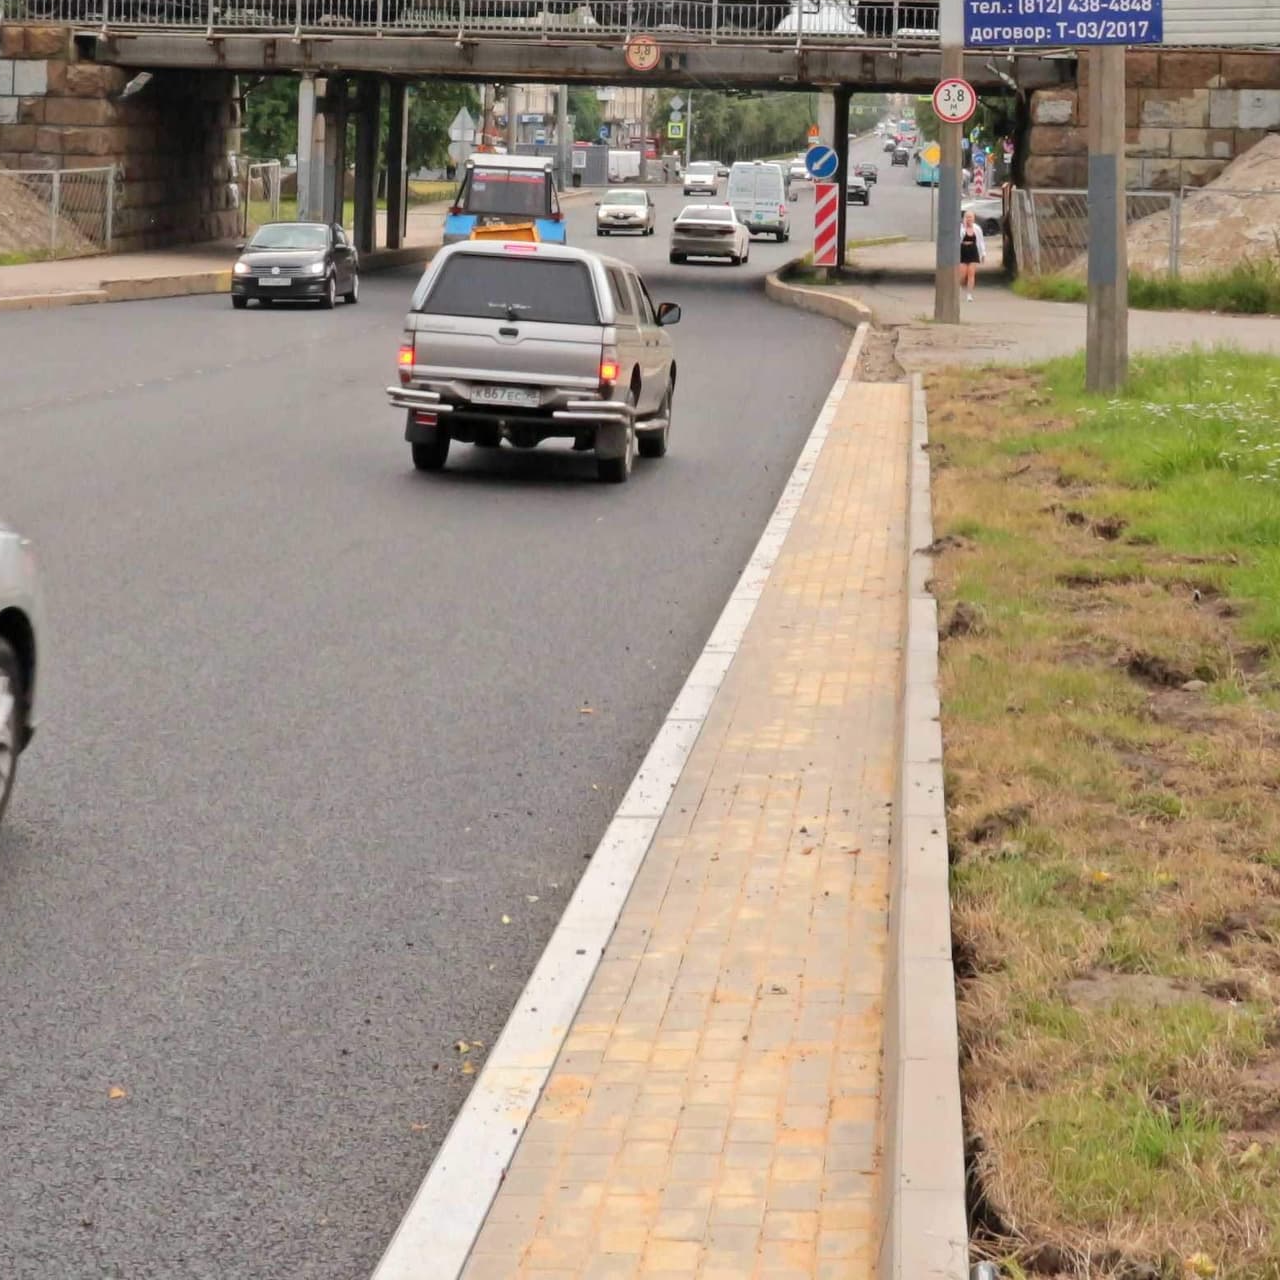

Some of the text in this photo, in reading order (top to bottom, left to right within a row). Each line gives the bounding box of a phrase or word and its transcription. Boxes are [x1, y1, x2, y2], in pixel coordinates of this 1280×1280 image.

[970, 1, 1013, 14] тел.:
[970, 20, 1149, 42] договор: Т-03/2017
[943, 89, 965, 102] 3,8
